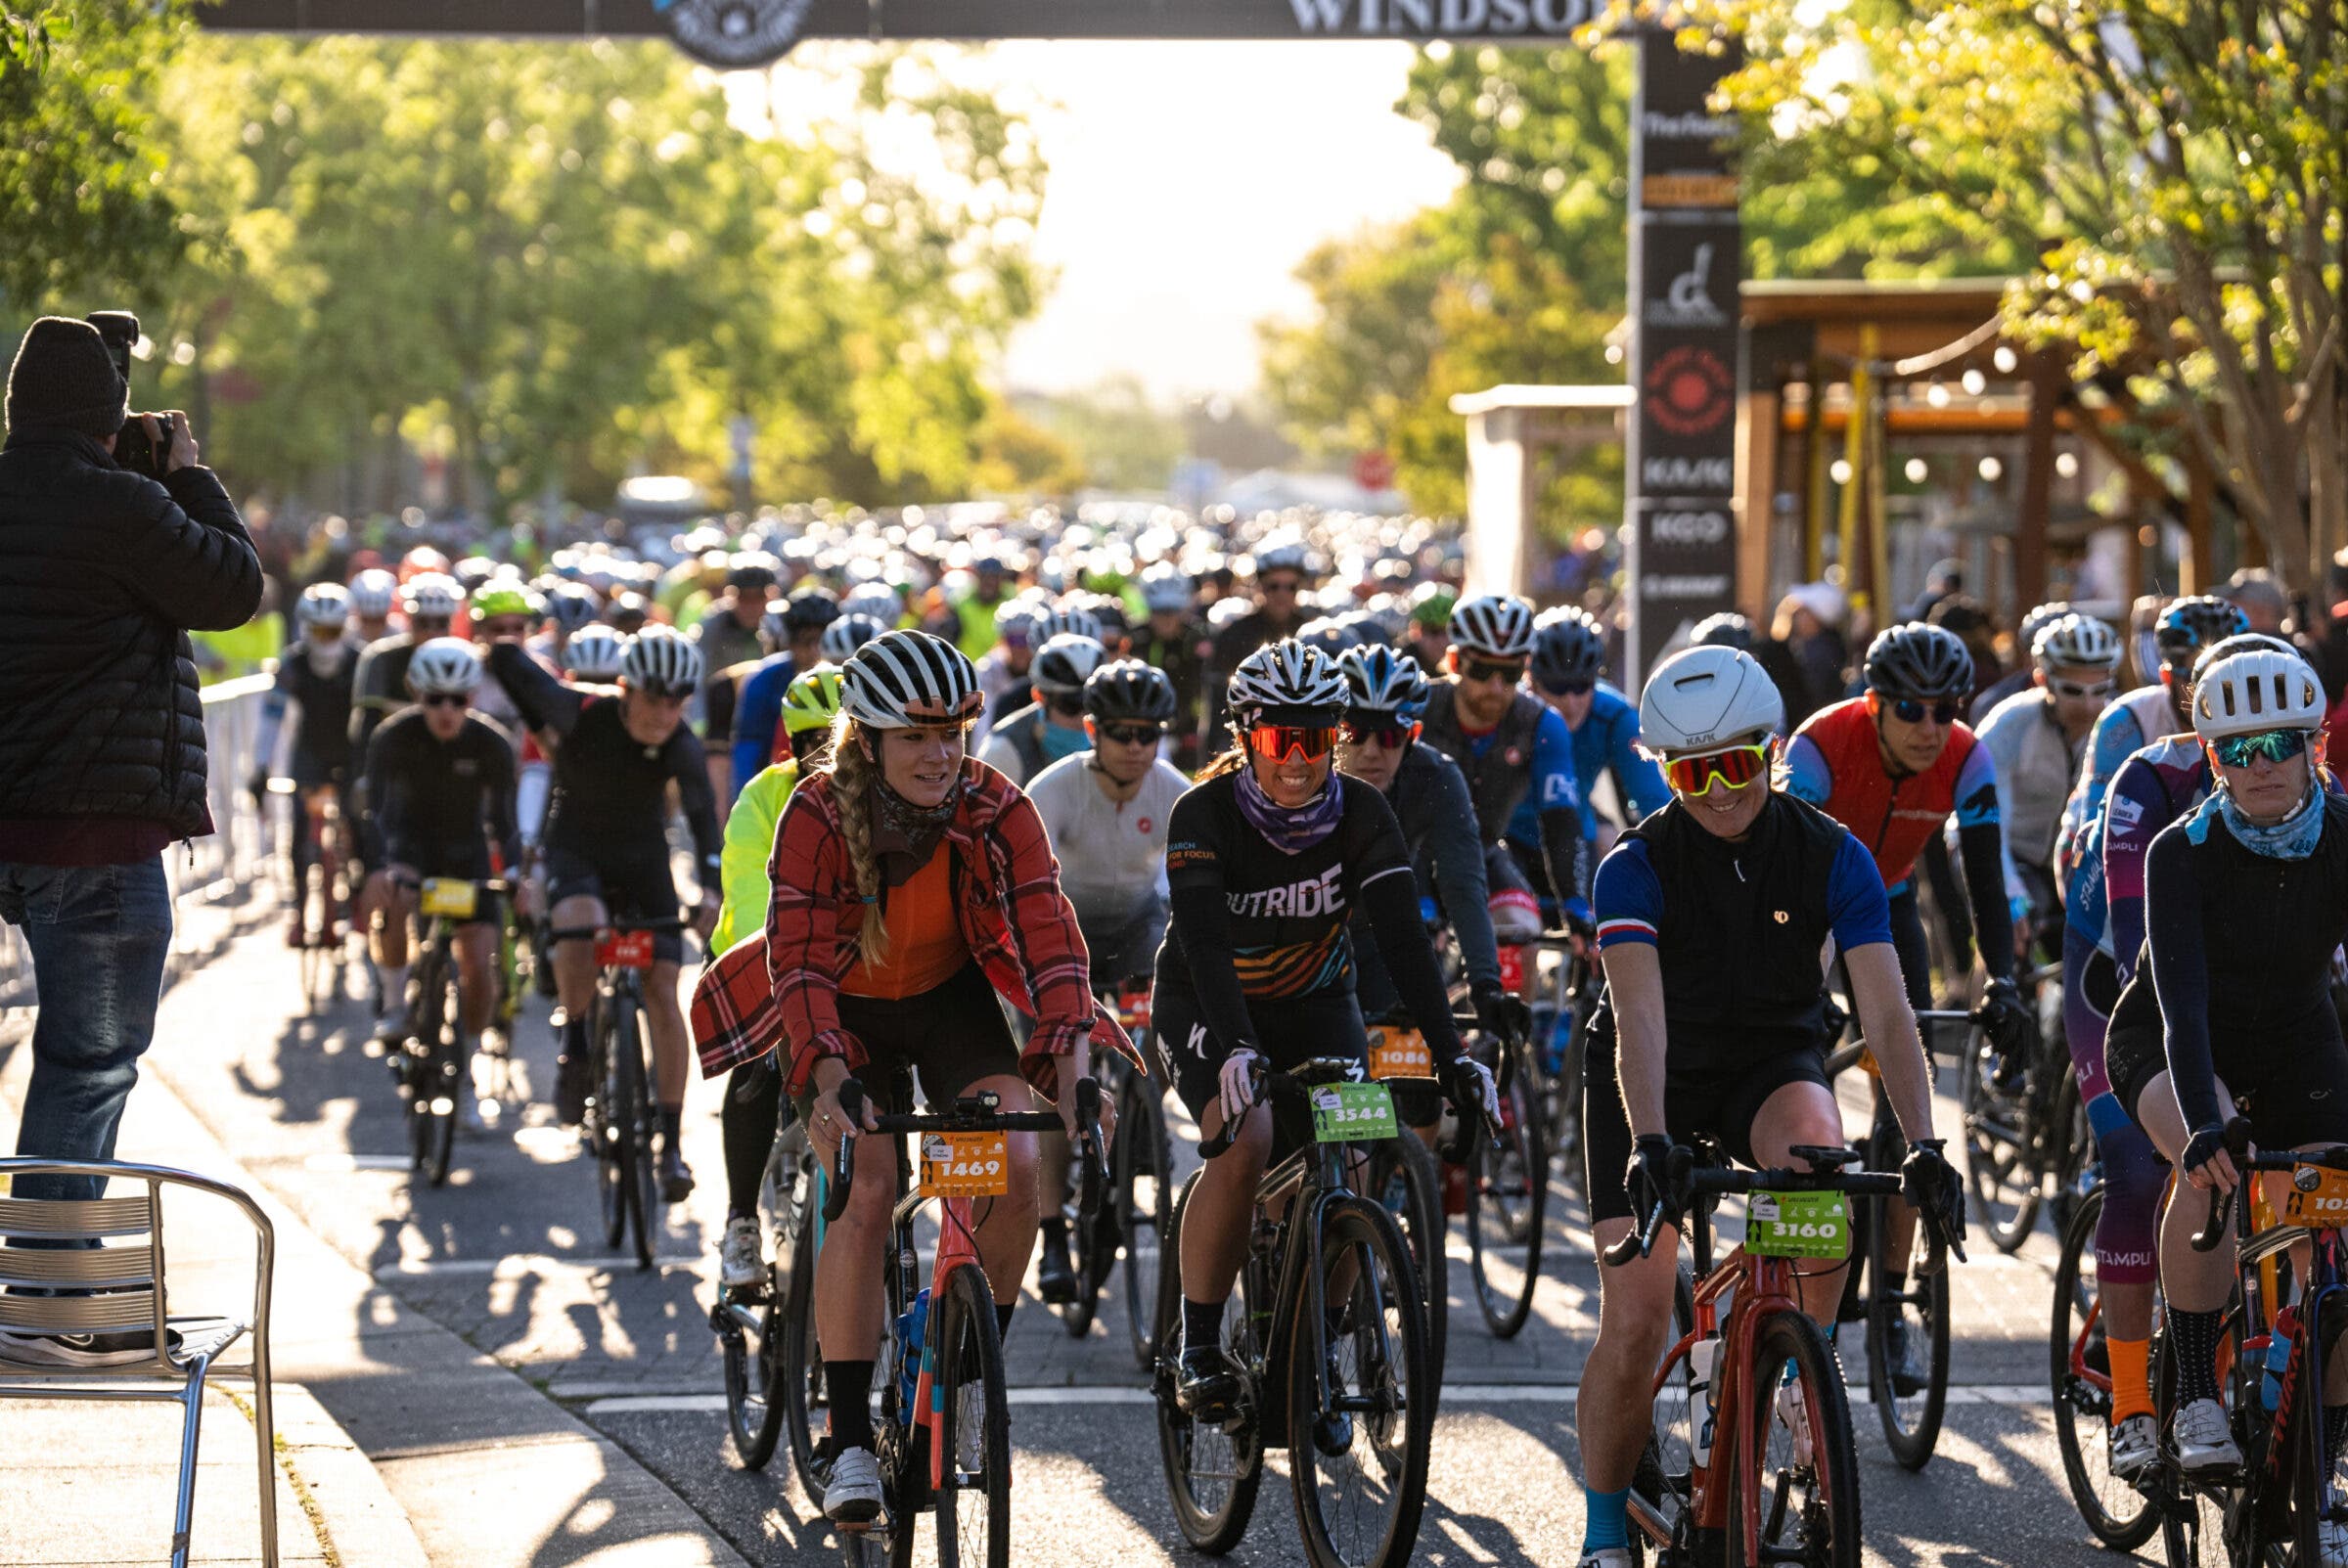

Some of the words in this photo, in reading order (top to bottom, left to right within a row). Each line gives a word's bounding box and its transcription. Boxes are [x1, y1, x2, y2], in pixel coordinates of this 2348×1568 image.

[1288, 0, 1609, 33] WINDSO
[1185, 850, 1216, 860] FOCUS
[1380, 1051, 1427, 1065] 1086
[1334, 1106, 1387, 1122] 3544
[941, 1160, 1000, 1177] 1469
[1772, 1222, 1837, 1238] 3160
